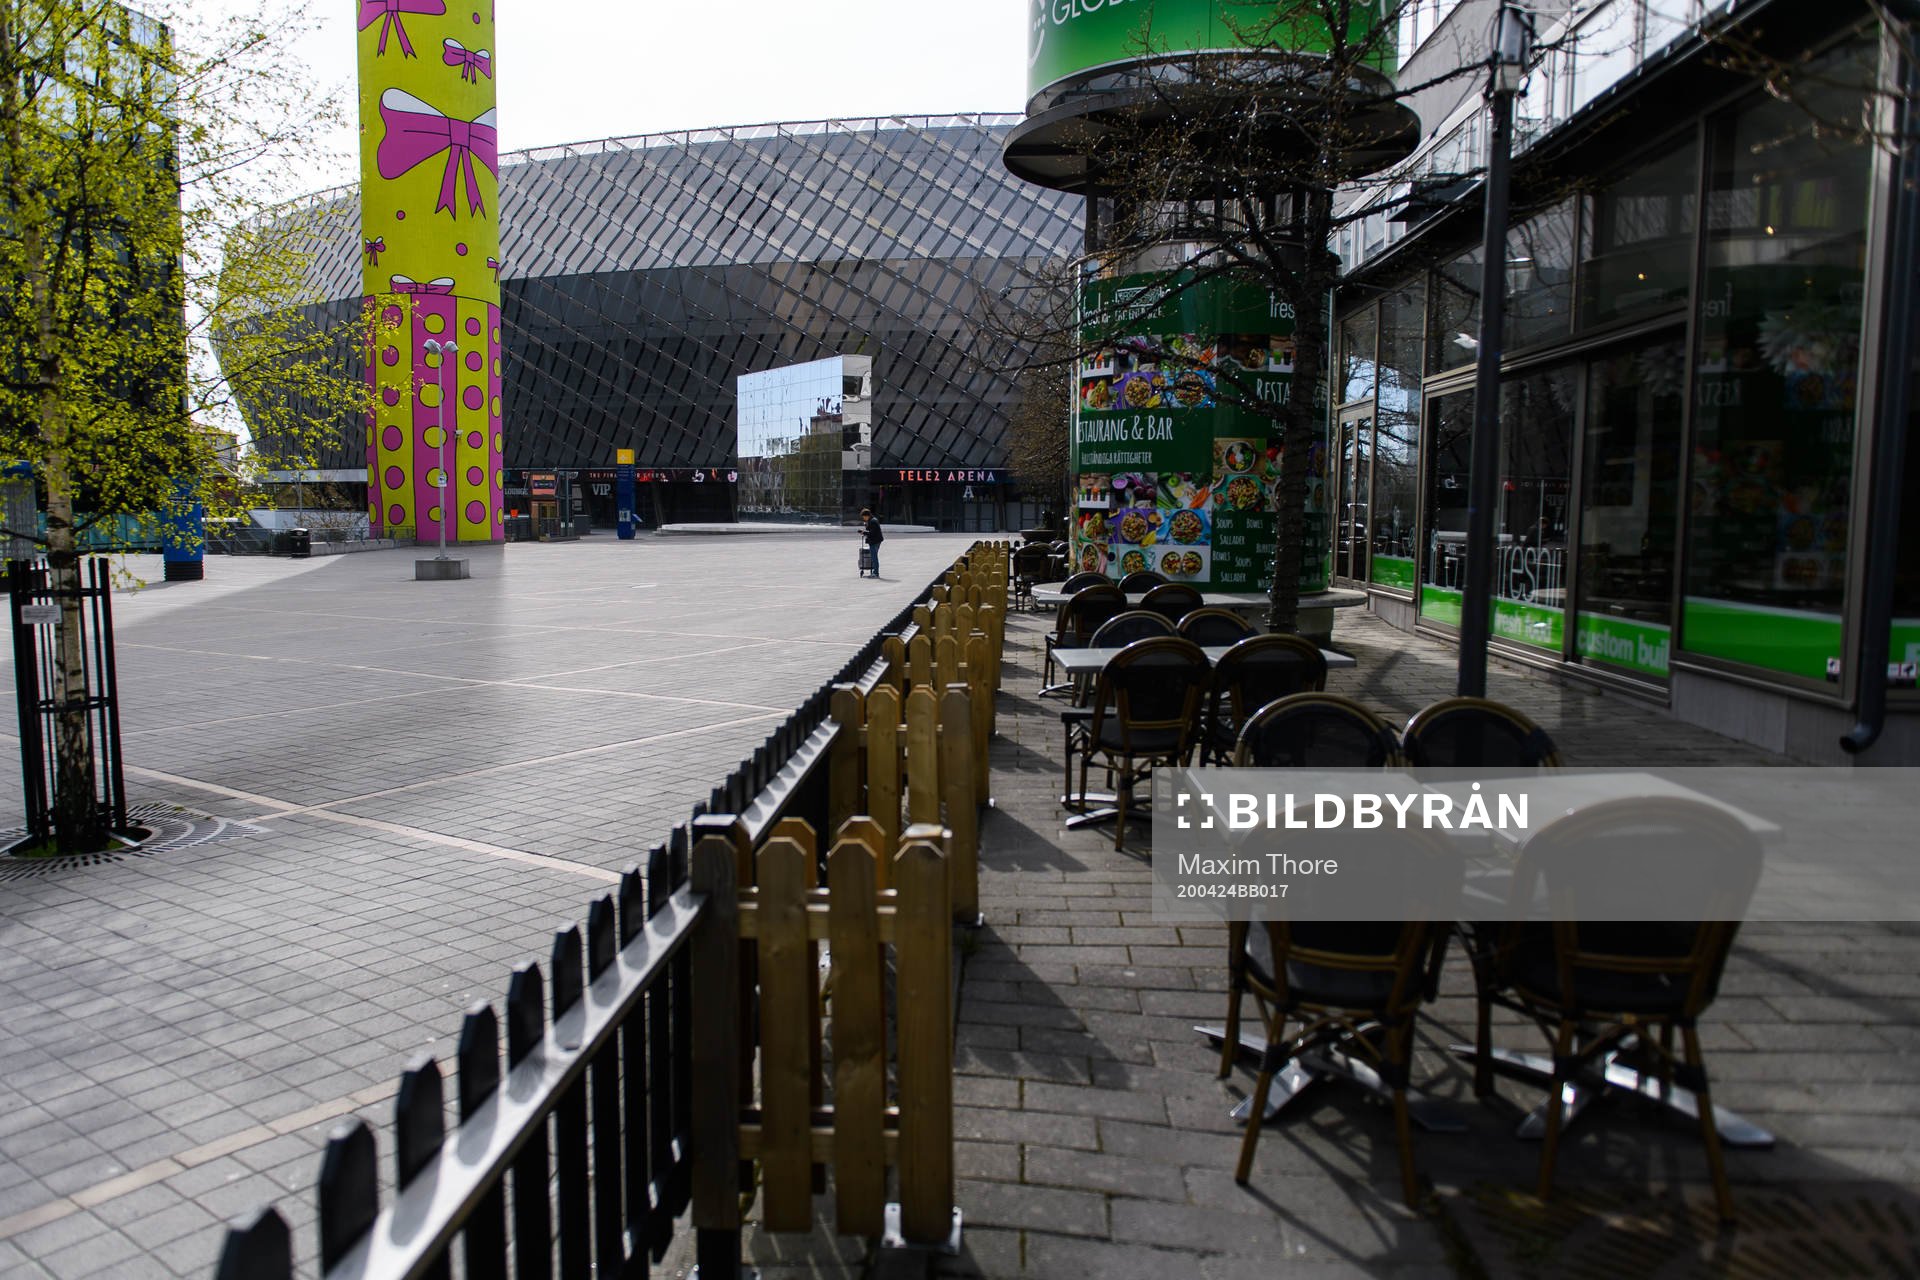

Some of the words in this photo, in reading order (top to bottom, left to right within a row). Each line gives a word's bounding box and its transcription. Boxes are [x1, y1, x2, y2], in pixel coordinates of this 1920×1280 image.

[1078, 418, 1128, 443] ESTAURANG
[1131, 414, 1144, 441] &
[1147, 414, 1174, 441] BAR
[899, 470, 940, 482] TELE2
[947, 470, 996, 482] ARENA
[592, 483, 612, 496] VIP
[963, 485, 974, 498] A
[1577, 629, 1635, 662] custom
